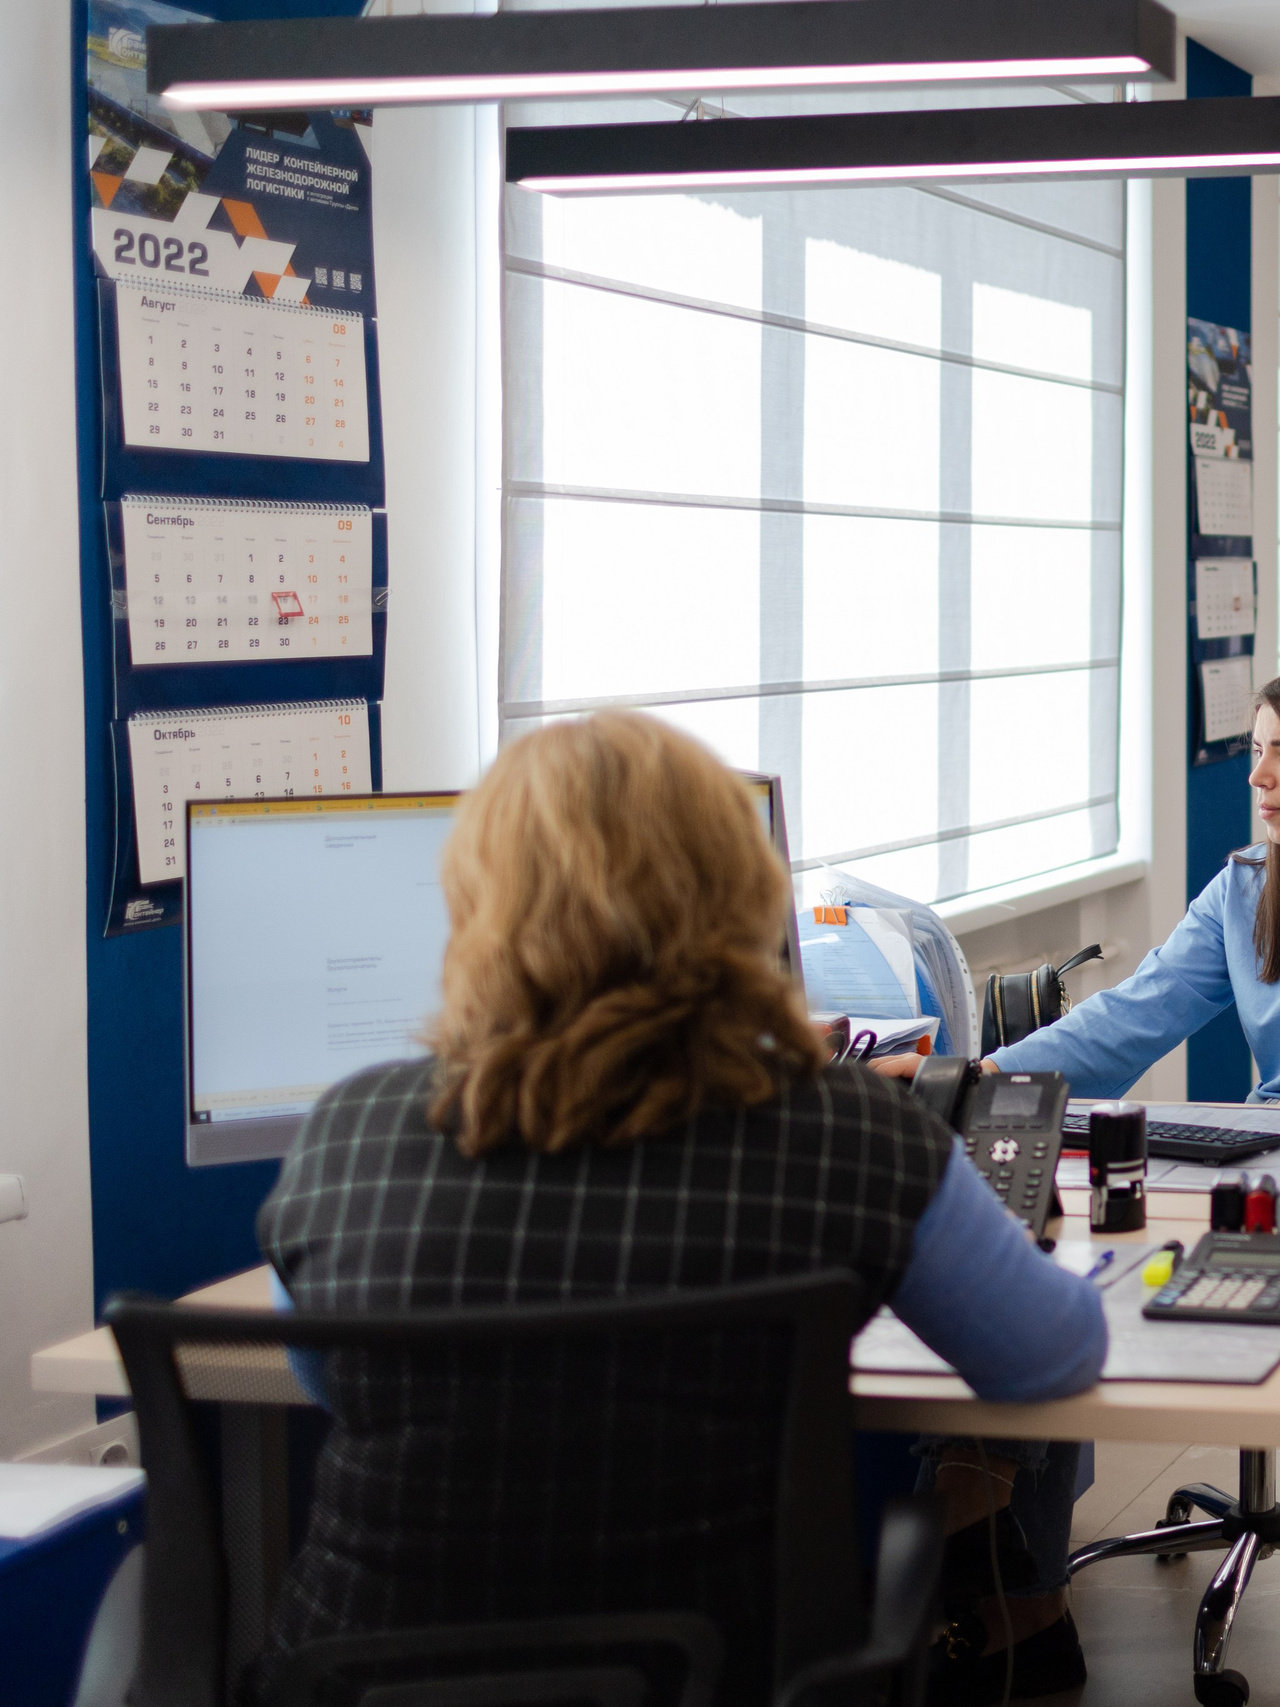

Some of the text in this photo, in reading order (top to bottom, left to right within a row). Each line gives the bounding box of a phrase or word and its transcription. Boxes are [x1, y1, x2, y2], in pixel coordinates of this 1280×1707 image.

[246, 147, 359, 182] ЛИДЕР КОНТЕЙНЕРНОЙ
[246, 163, 350, 195] ЖЕЛЕЗНОДОРОЖНОЙ
[246, 179, 305, 201] ЛОГИСТИКИ
[113, 227, 210, 278] 2022
[140, 296, 176, 312] Август
[332, 323, 347, 335] 08
[148, 335, 340, 367] 1 2 3 4 5 6 7
[148, 357, 344, 387] 8 9 10 11 12 13 14
[147, 379, 344, 407] 15 16 17 18 19 20 21
[148, 402, 346, 428] 22 23 24 25 26 27 28
[149, 424, 160, 434] 29
[181, 427, 193, 437] 30
[213, 430, 224, 439] 31
[308, 437, 314, 447] 3
[338, 440, 344, 448] 4
[146, 513, 195, 529] Сентябрь
[337, 520, 353, 531] 09
[248, 553, 253, 562] 1
[278, 554, 284, 563] 2
[309, 554, 314, 563] 3
[339, 555, 345, 563] 4
[154, 574, 348, 584] 5 6 7 8 9 10 11
[153, 596, 164, 606] 12
[185, 595, 196, 605] 13
[216, 595, 228, 605] 14
[247, 595, 258, 605] 15
[308, 595, 318, 604] 17
[338, 594, 349, 604] 18
[154, 615, 349, 628] 19 20 21 22 23 24 25
[155, 636, 347, 651] 26 27 28 29 30 1 2
[337, 714, 351, 726] 10
[153, 727, 196, 742] Октябрь
[313, 752, 318, 761] 1
[341, 750, 346, 758] 2
[163, 765, 348, 794] 3 4 5 6 7 8 9
[162, 802, 173, 811] 10
[312, 784, 323, 794] 15
[341, 781, 351, 791] 16
[163, 820, 173, 830] 17
[164, 838, 175, 848] 24
[165, 856, 176, 866] 31
